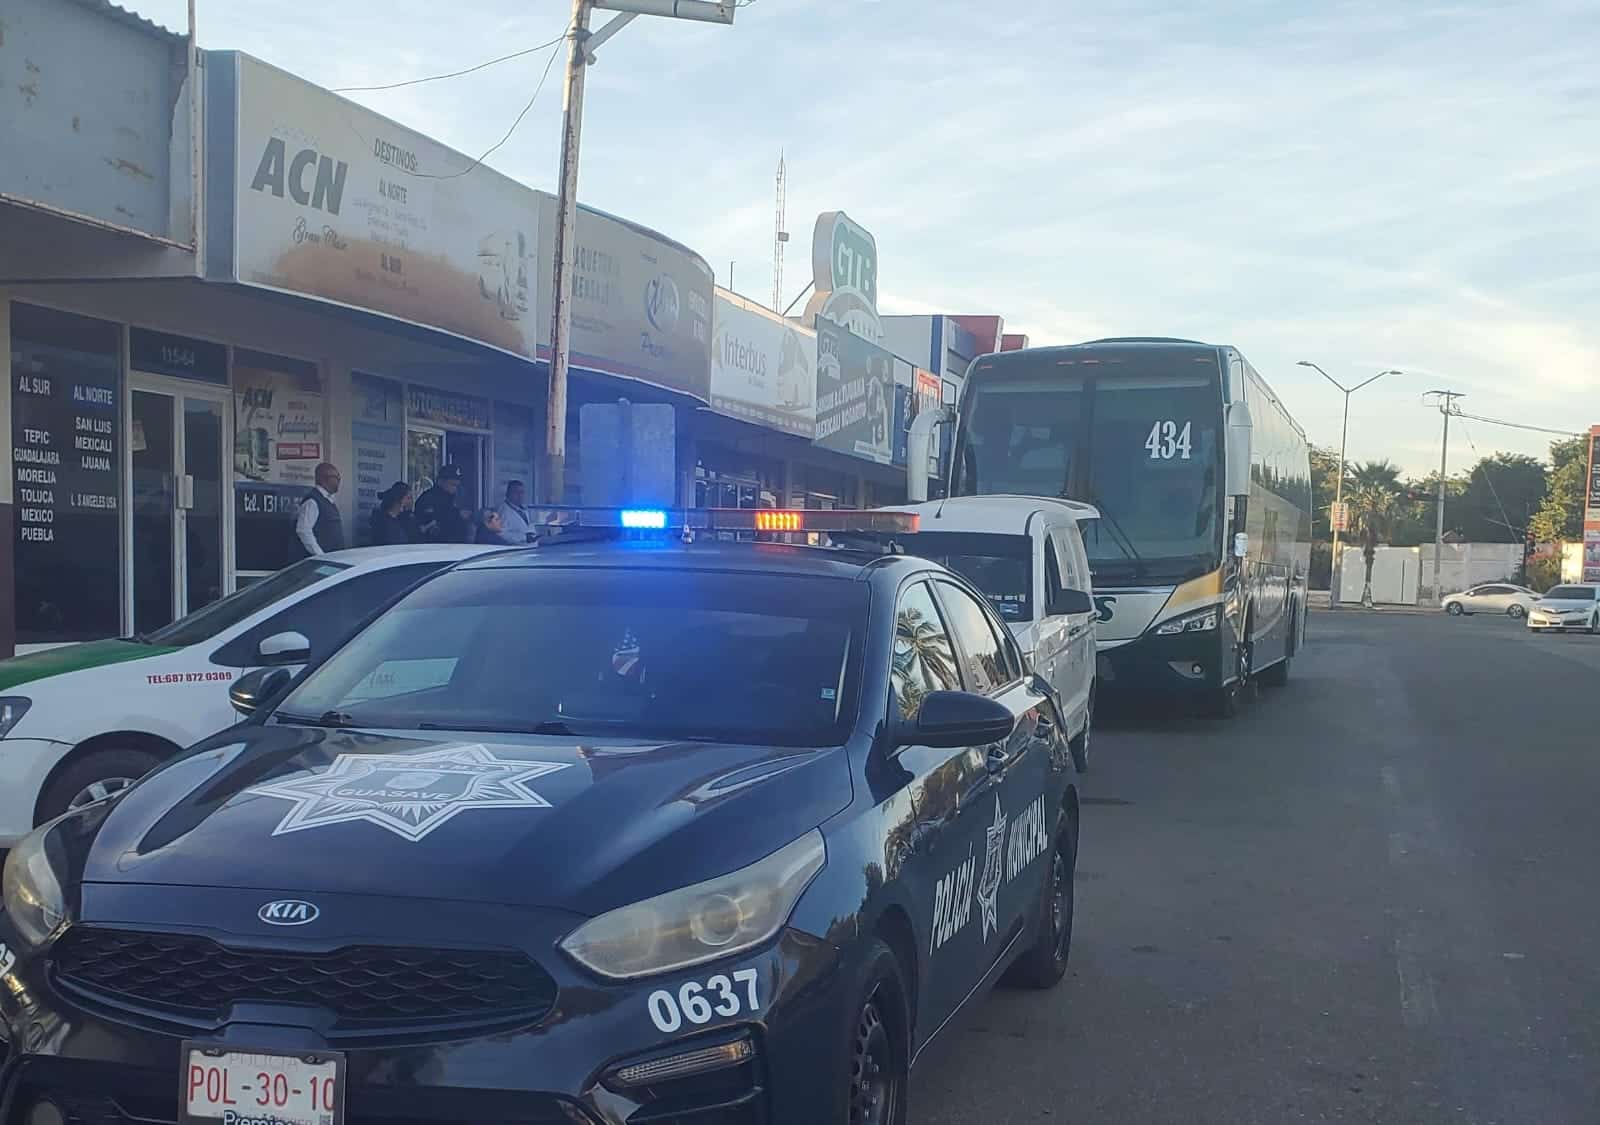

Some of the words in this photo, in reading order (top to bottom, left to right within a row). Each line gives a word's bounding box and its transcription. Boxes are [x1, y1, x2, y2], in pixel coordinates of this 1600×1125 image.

[250, 137, 348, 216] ACN
[19, 376, 31, 392] AL
[33, 378, 51, 395] SUR
[73, 385, 84, 401] AL
[86, 386, 112, 405] NORTE
[75, 417, 92, 431] SAN
[94, 419, 112, 434] LUIS
[24, 429, 49, 444] TEPIC
[75, 436, 112, 452] MEXICALI
[1144, 420, 1192, 459] 434
[14, 448, 60, 464] GUADALAJARA
[17, 468, 57, 484] MORELIA
[21, 489, 54, 504] TOLUCA
[21, 508, 54, 523] MEXICO
[21, 528, 54, 541] PUEBLA
[337, 788, 452, 800] GUASAVE
[1006, 793, 1048, 886] MUNICIPAL
[265, 903, 307, 920] KIA
[647, 967, 760, 1033] 0637
